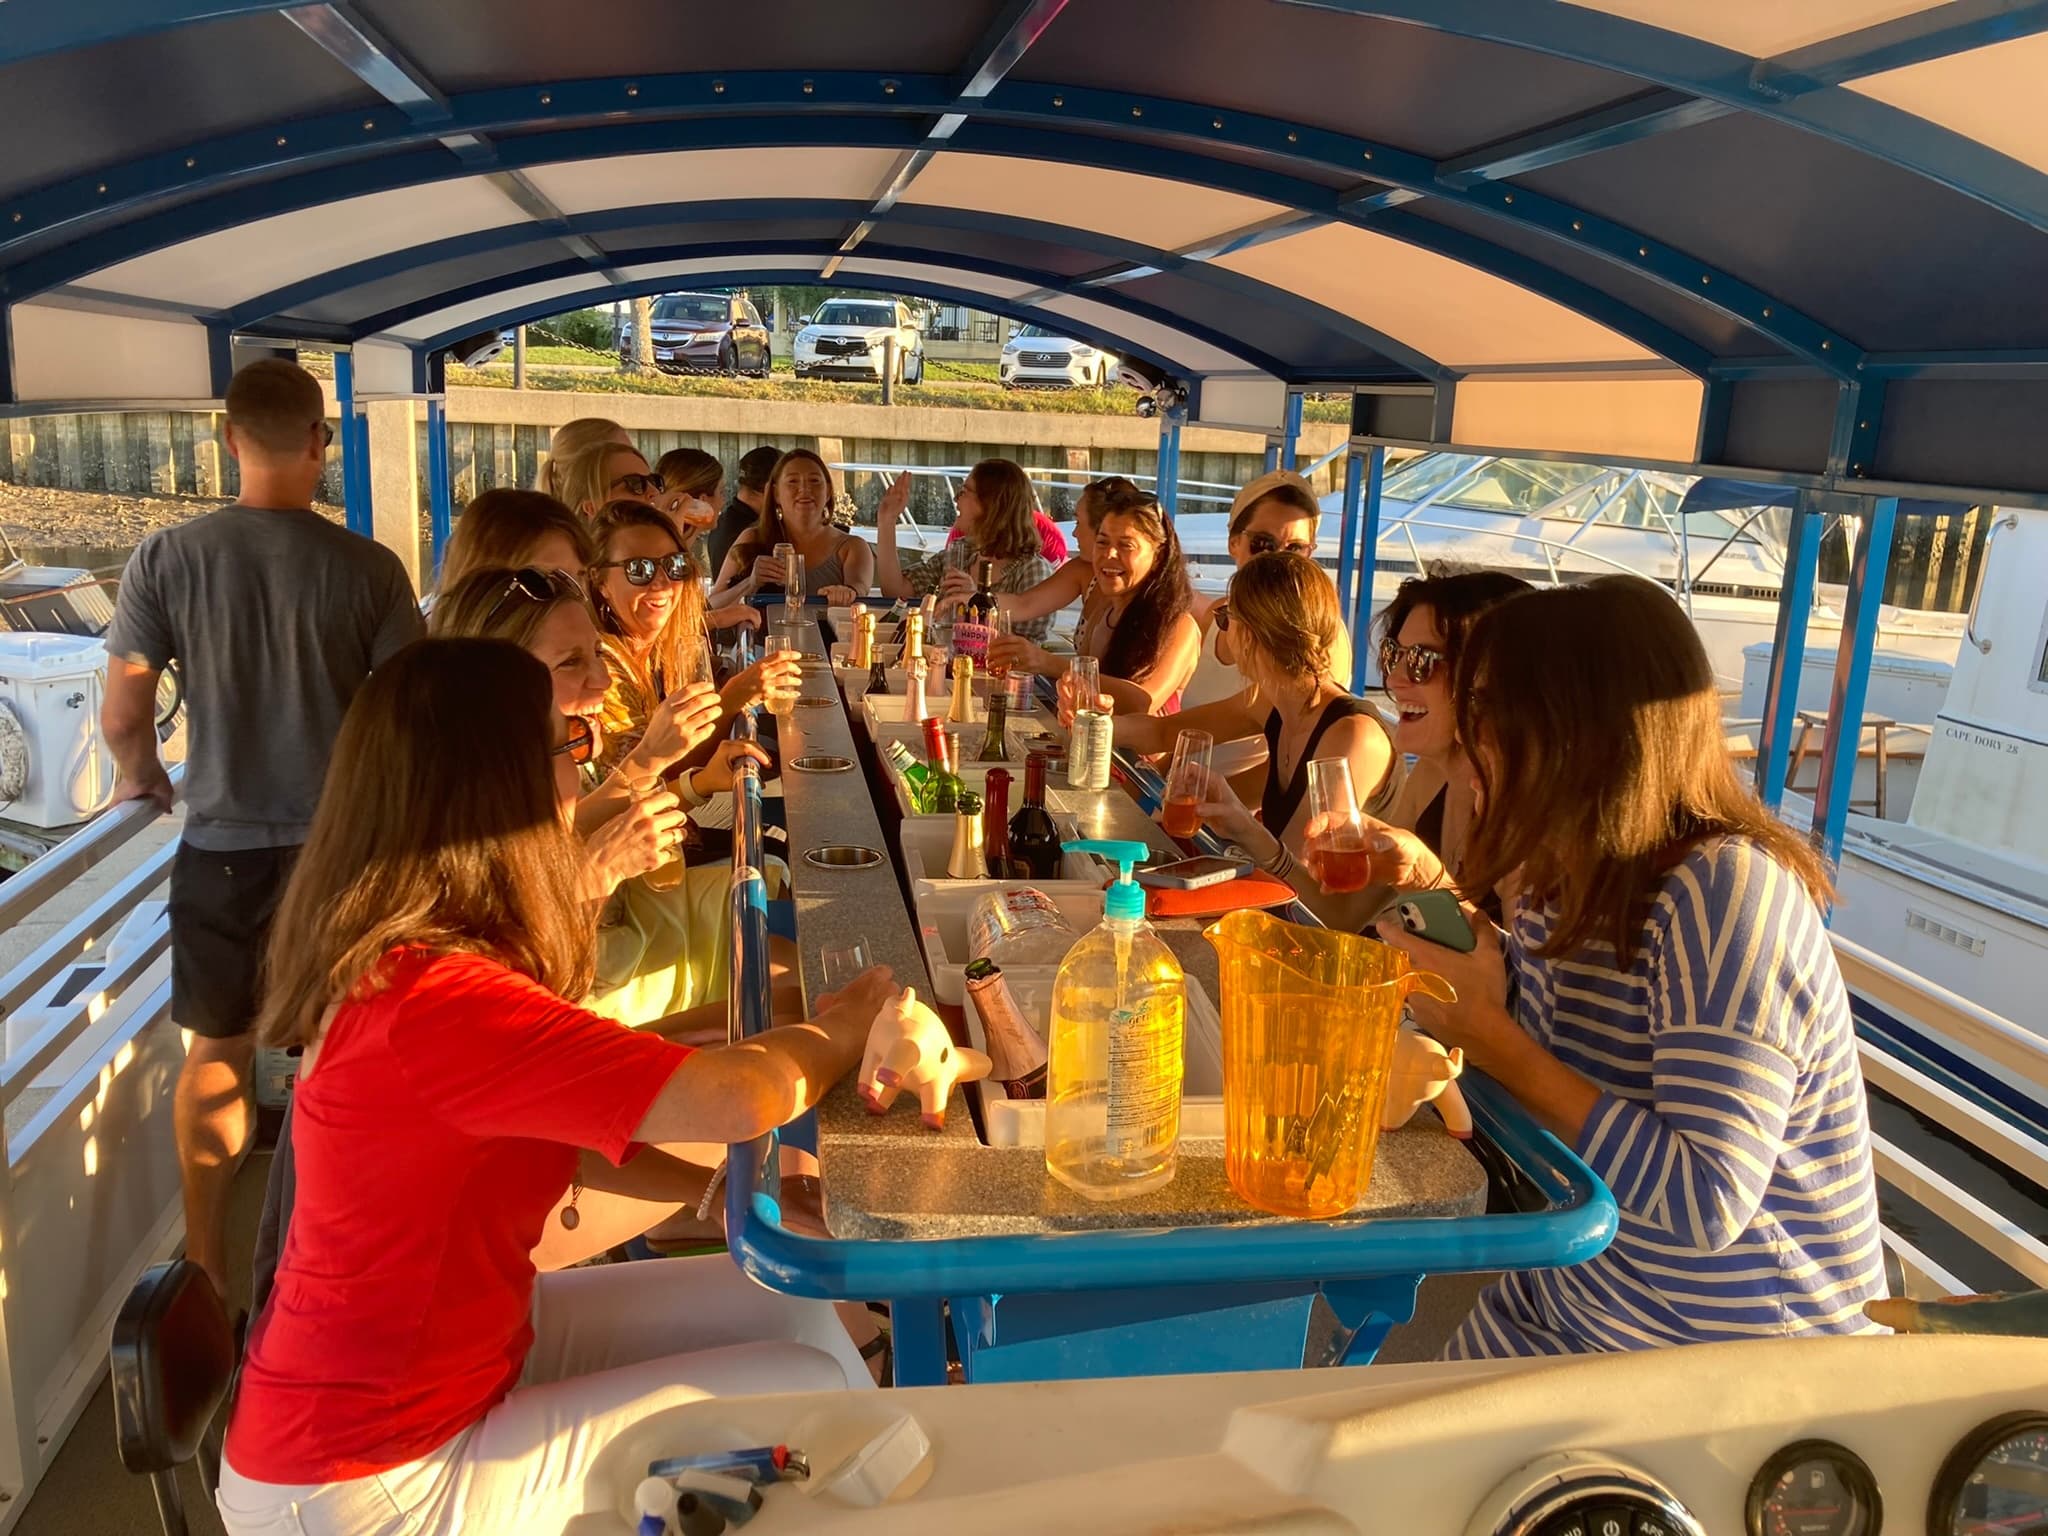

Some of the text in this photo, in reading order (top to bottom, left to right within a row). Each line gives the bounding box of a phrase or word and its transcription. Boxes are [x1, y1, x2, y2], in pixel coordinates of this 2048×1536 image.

[961, 631, 987, 641] HAPPY
[1945, 727, 2019, 755] CAPE DORY 28
